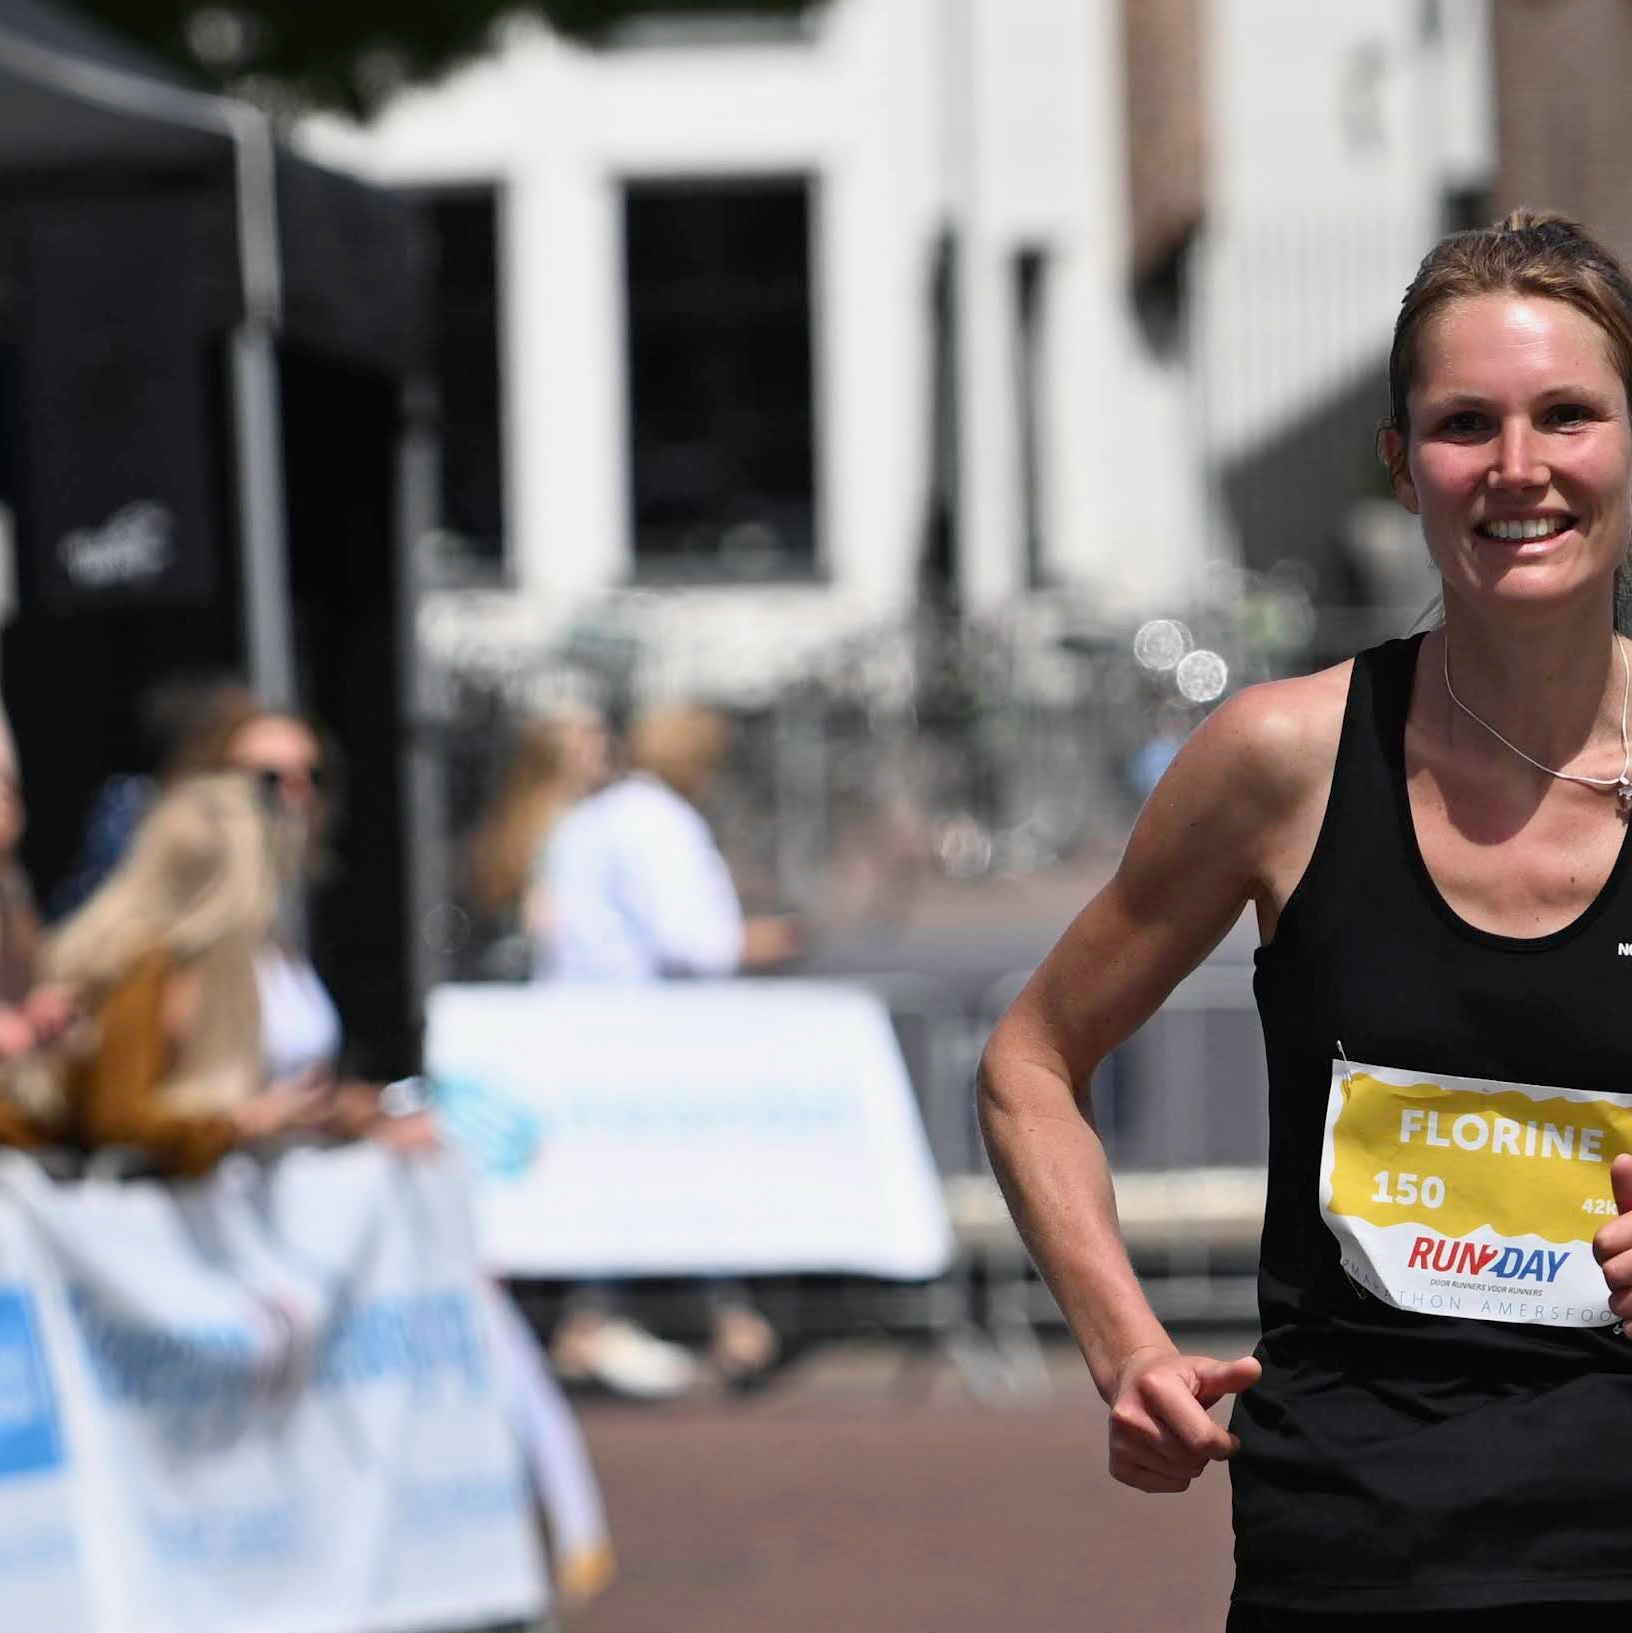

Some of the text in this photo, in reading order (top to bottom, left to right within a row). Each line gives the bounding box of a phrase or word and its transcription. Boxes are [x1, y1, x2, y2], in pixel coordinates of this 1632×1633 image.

[1399, 1108, 1605, 1163] FLORINE
[1371, 1170, 1617, 1216] 150 42k
[1407, 1236, 1572, 1283] RUN2DAY
[1430, 1278, 1543, 1297] DOOR RUNNERS VOOR RUNNERS
[1480, 1300, 1613, 1322] AMERSFOO
